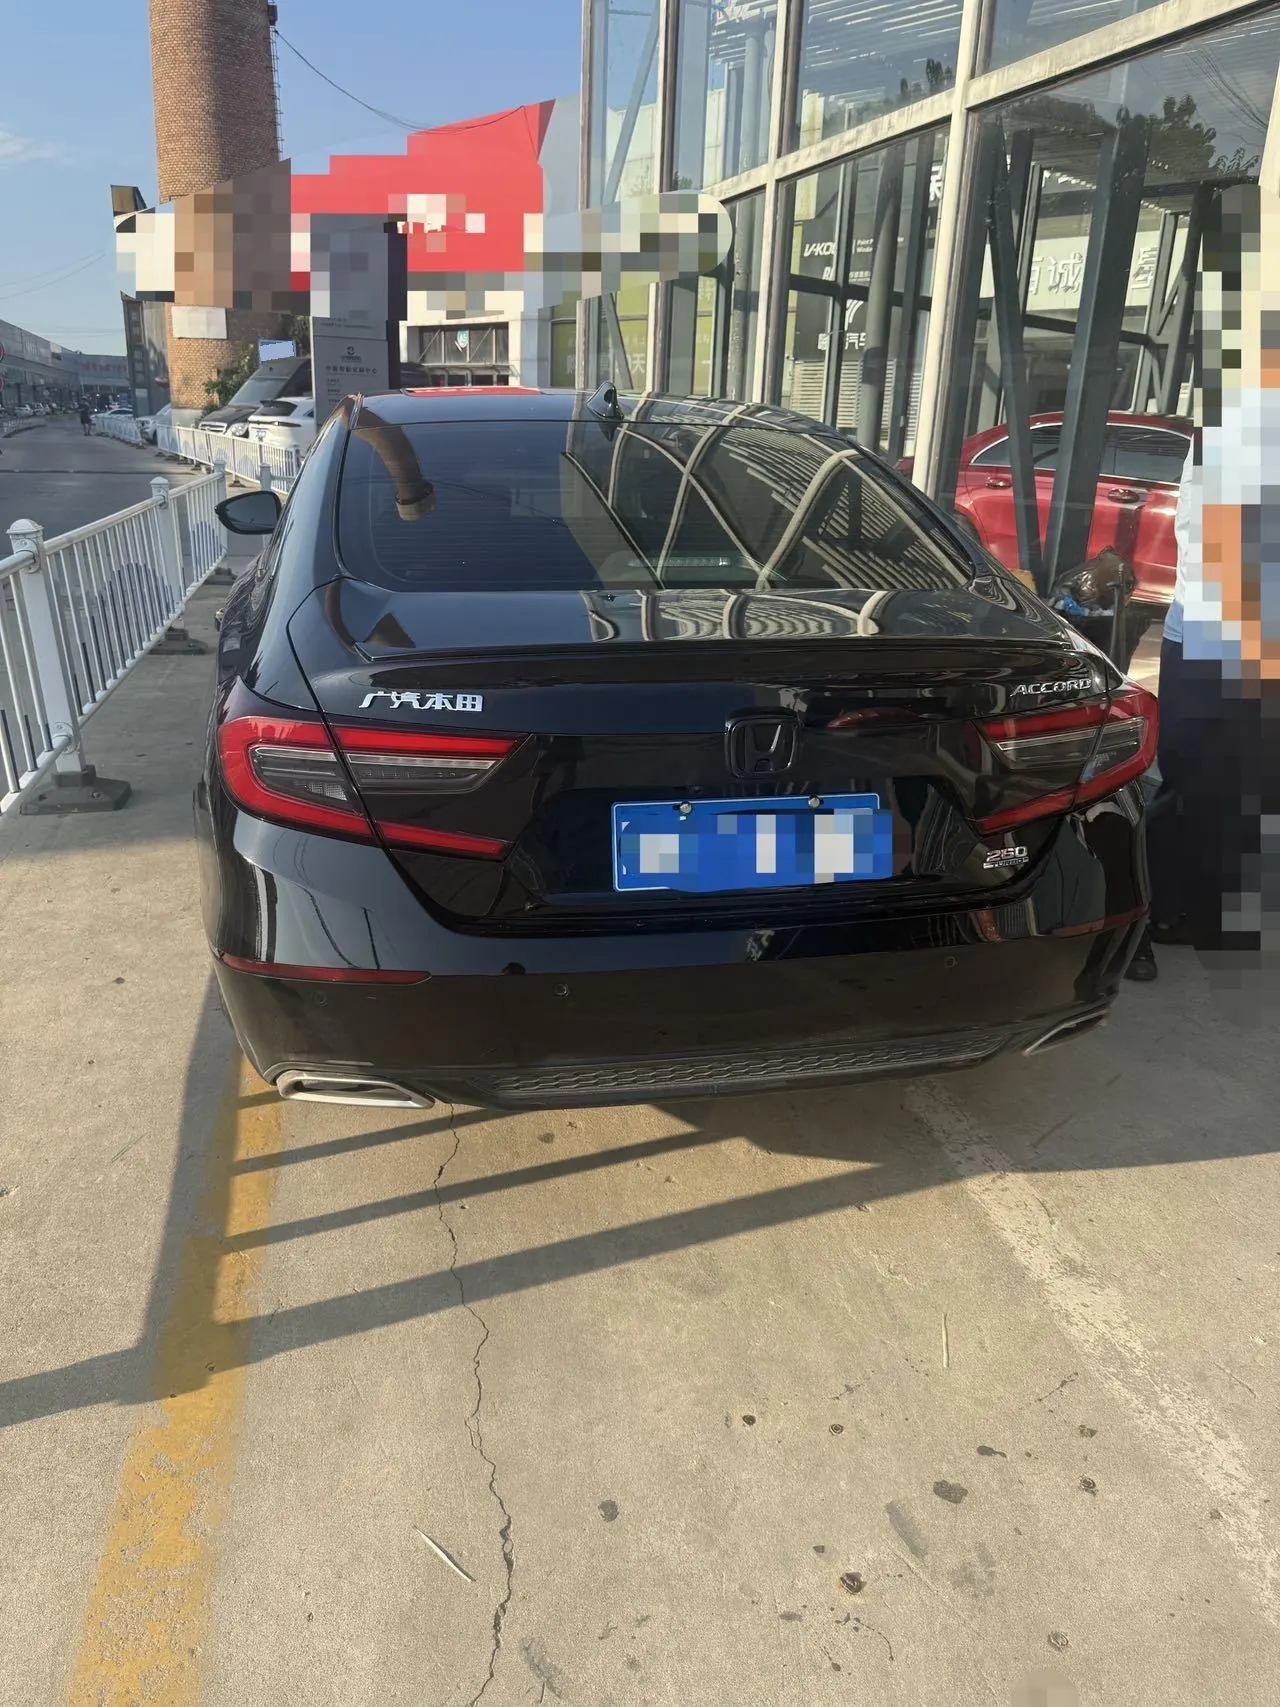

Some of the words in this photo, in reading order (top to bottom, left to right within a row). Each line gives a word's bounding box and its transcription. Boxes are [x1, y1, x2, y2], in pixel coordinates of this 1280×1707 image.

[1010, 678, 1092, 697] ACCORD
[358, 691, 484, 712] 广汽本田
